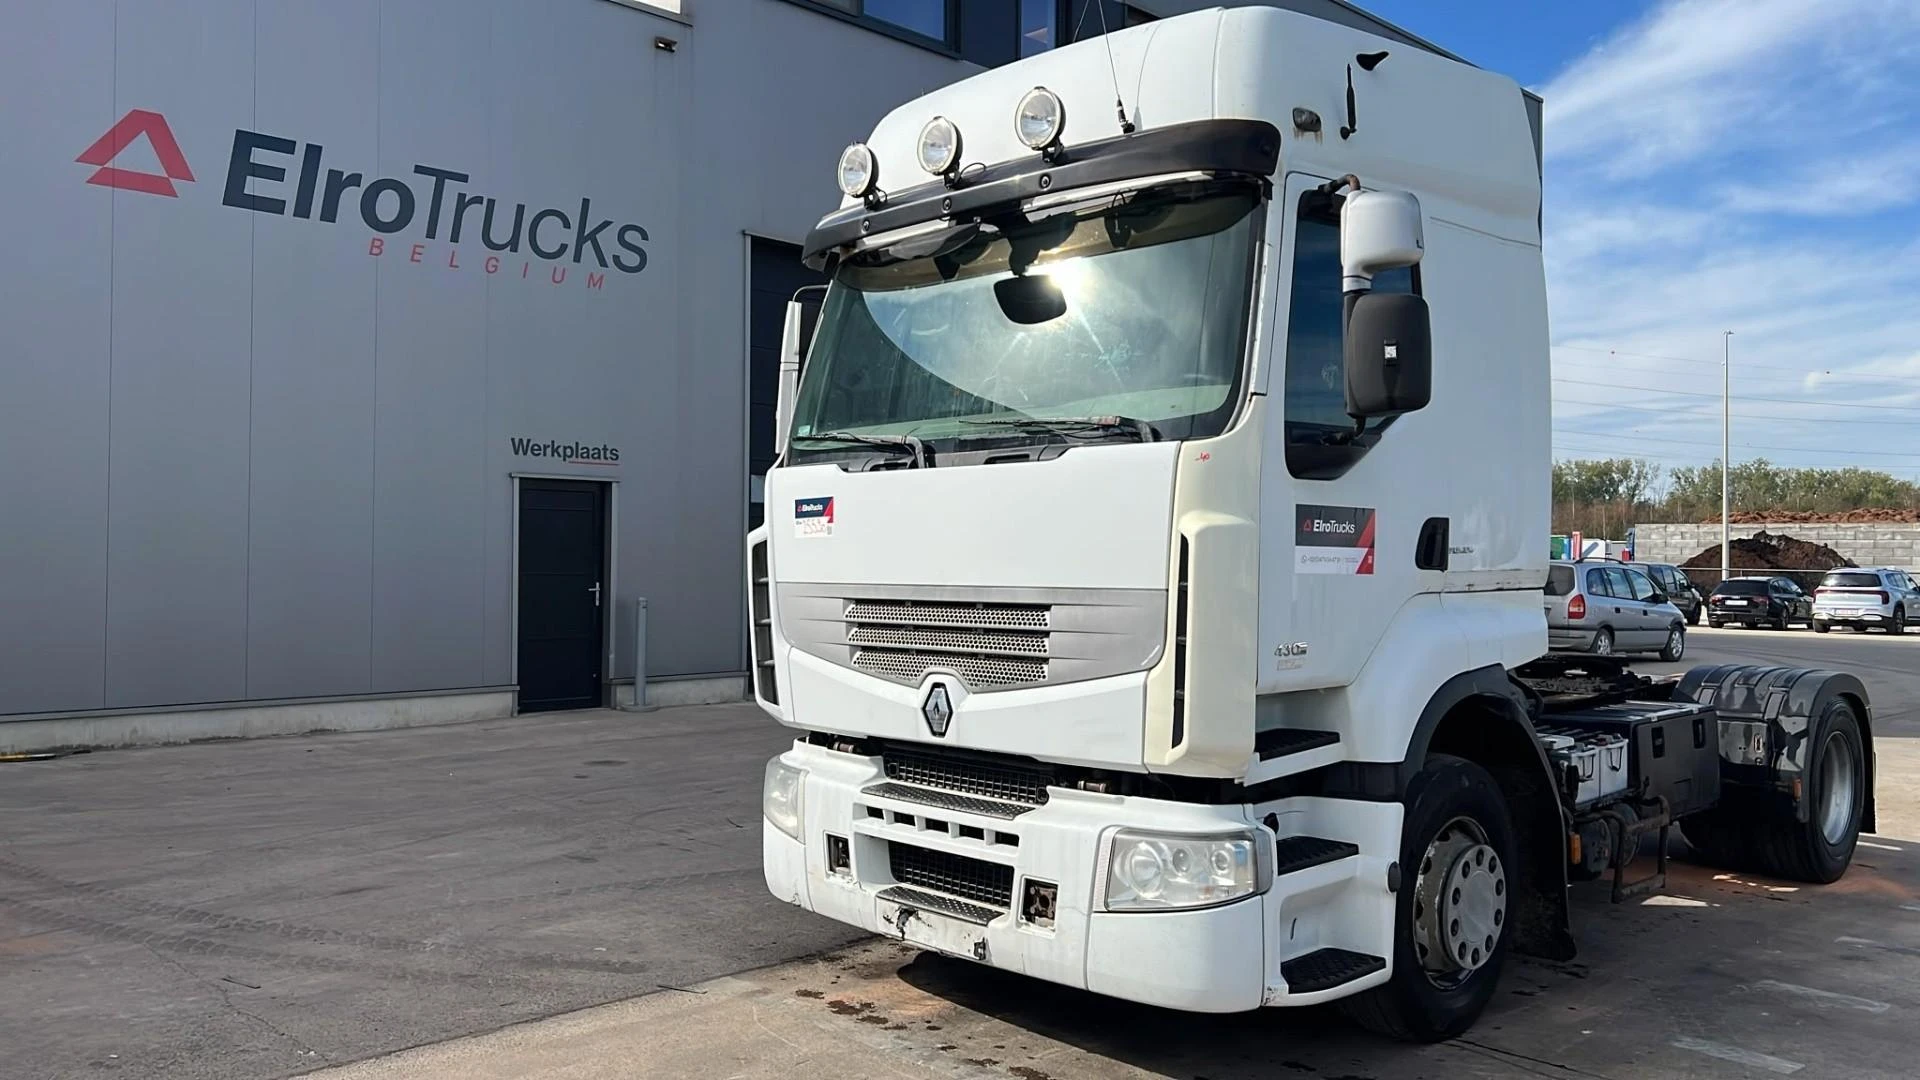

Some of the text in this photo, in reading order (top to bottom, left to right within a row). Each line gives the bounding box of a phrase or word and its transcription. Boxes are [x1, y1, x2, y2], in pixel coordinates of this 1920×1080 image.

[222, 129, 650, 274] ElroTrucks
[368, 237, 604, 290] BELGIUM
[510, 437, 620, 462] Werkplaats
[1313, 519, 1356, 534] ElroTrucks
